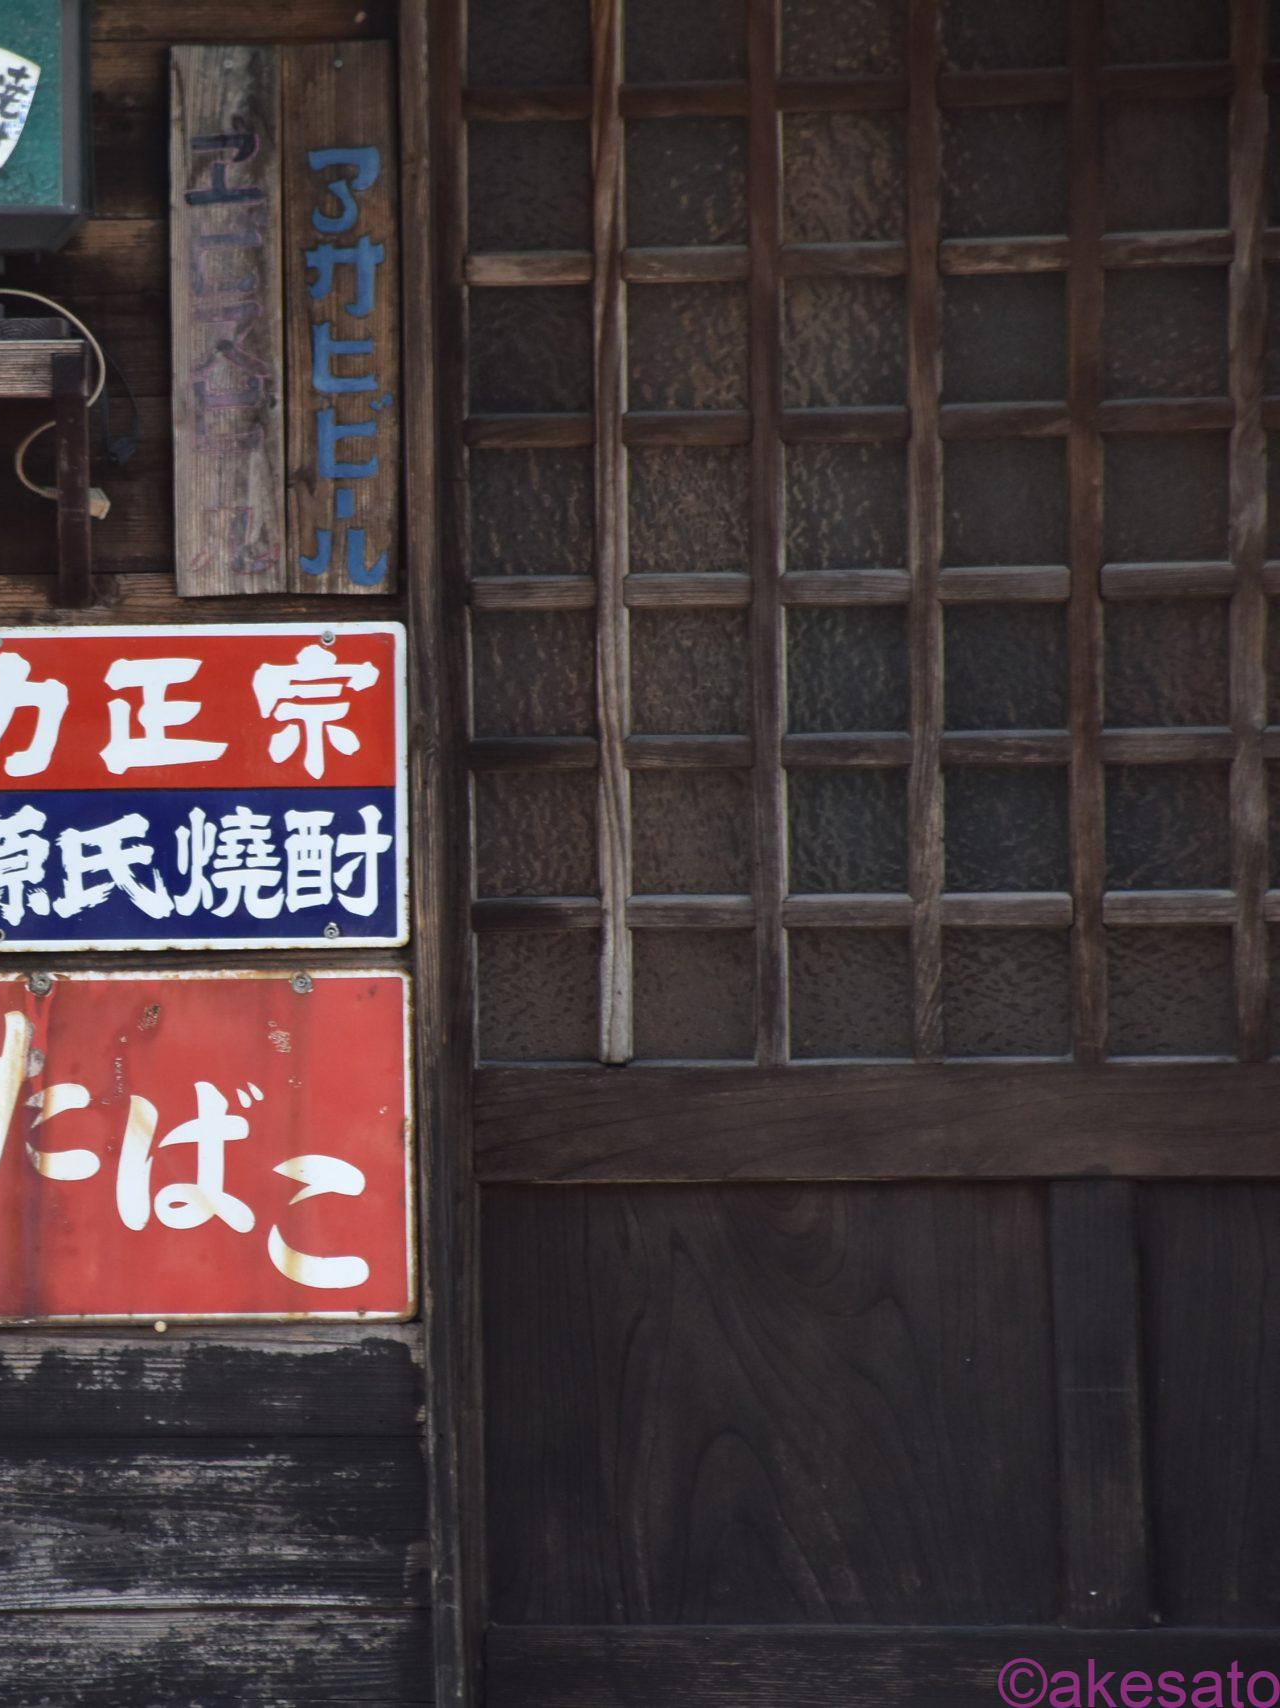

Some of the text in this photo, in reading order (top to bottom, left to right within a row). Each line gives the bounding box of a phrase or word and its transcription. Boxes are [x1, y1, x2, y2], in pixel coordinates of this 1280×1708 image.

[299, 147, 394, 587] アサヒビール
